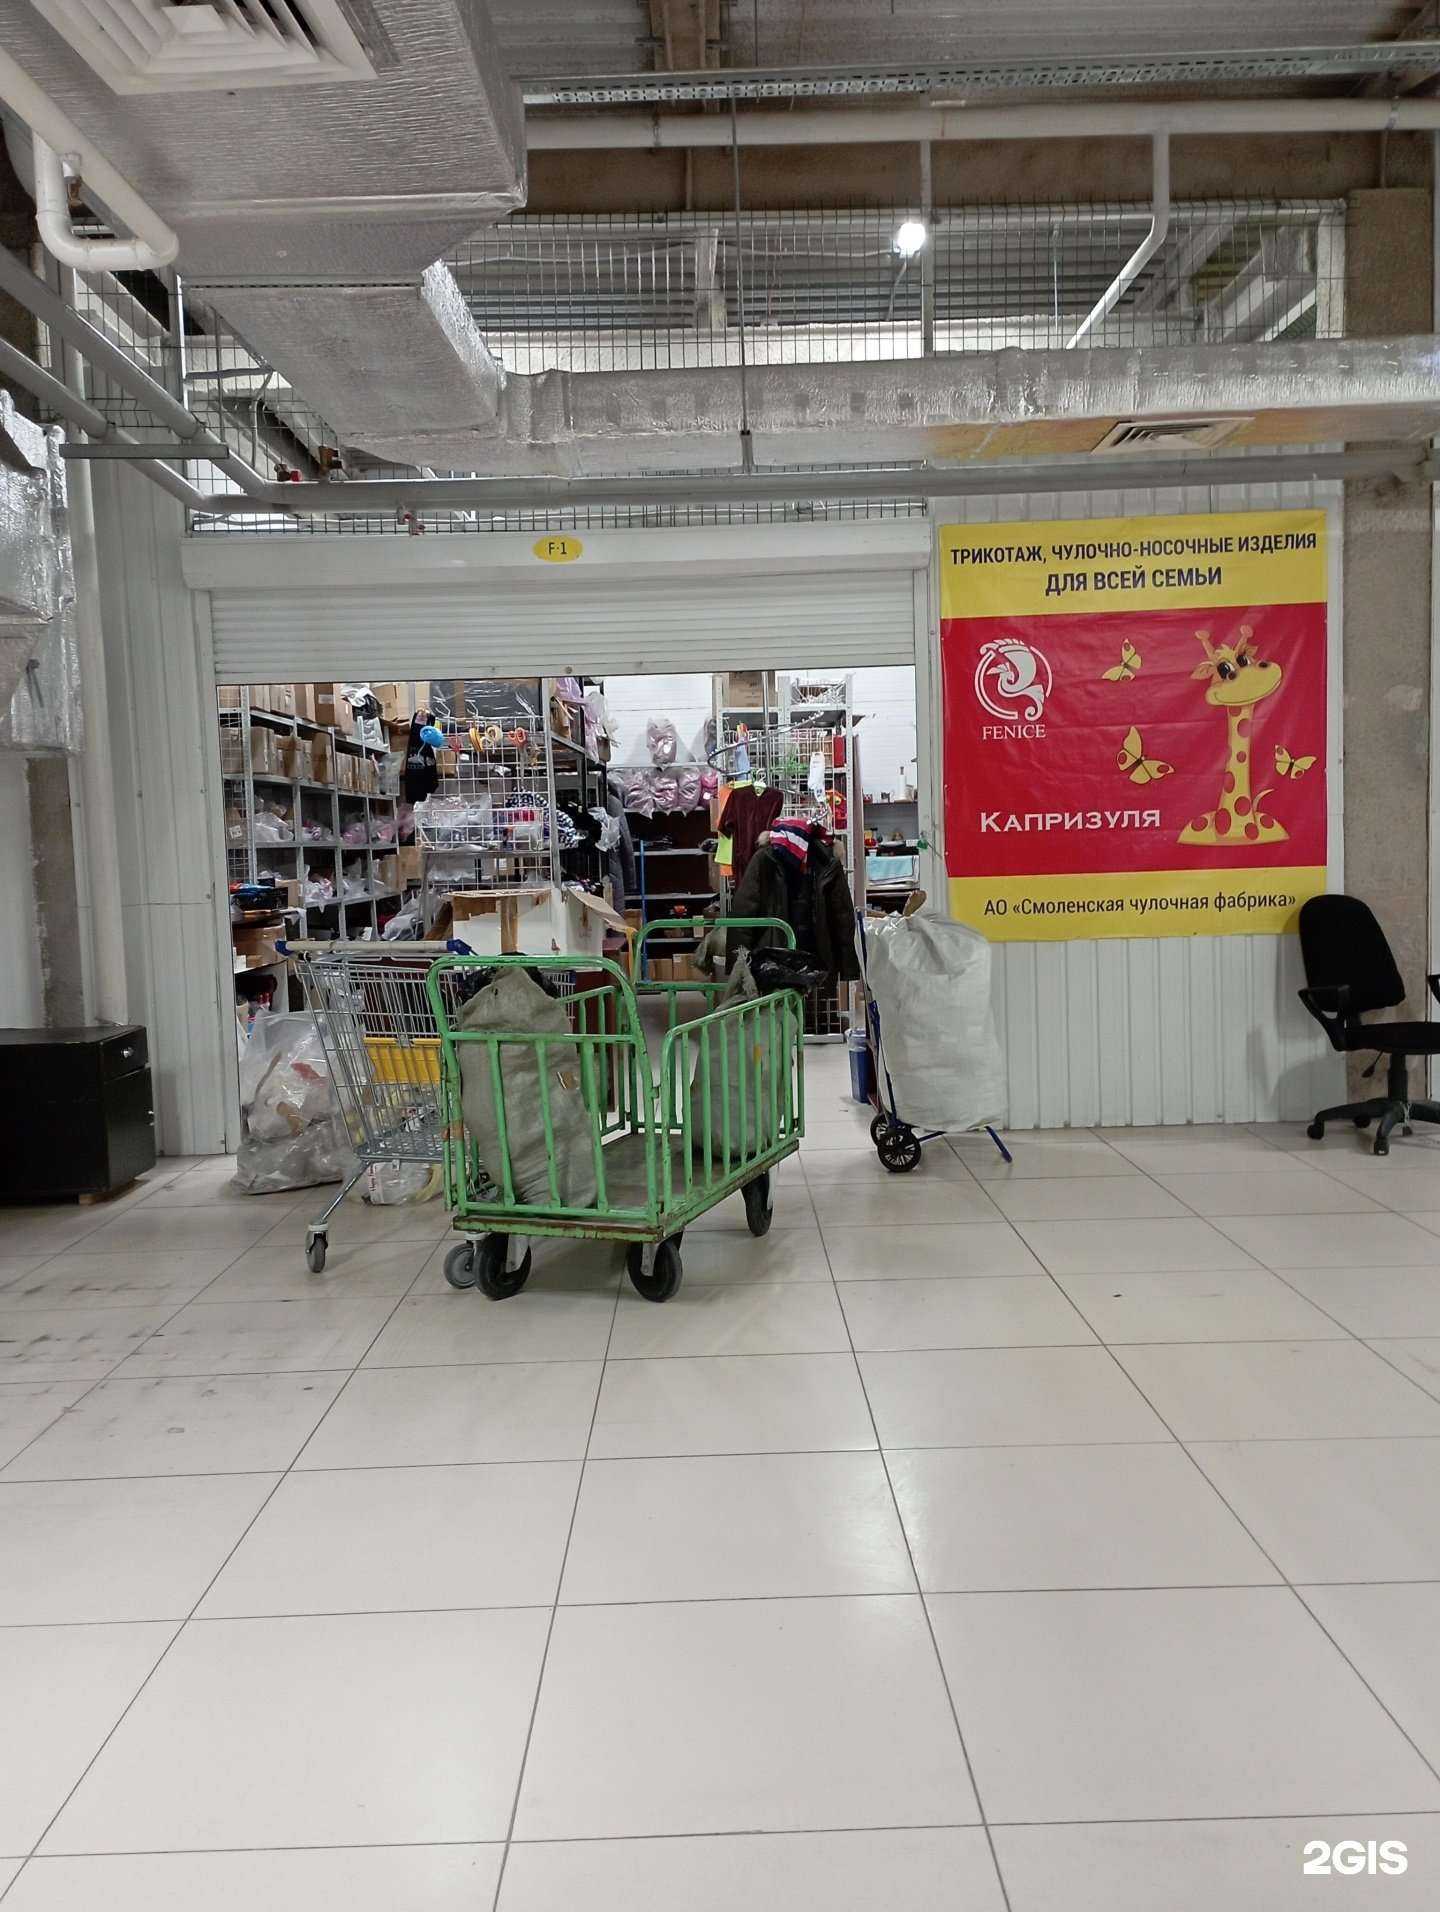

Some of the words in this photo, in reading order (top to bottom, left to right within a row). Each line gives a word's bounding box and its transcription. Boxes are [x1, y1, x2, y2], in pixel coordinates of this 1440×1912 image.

[950, 545, 1048, 565] ТРИКОТАЖ,
[1051, 536, 1234, 562] ЧУЛОЧНО-НОСОЧНЫЕ
[1237, 532, 1318, 555] ИЗДЕЛИЯ
[1045, 572, 1088, 597] ДЛЯ
[1093, 564, 1147, 591] ВСЕЙ
[1151, 566, 1223, 588] СЕМЬИ
[982, 724, 1047, 741] FENICE
[983, 898, 1008, 916] АО
[1012, 896, 1125, 916] «Смоленская
[1128, 895, 1209, 916] чулочная
[1213, 891, 1296, 912] фабрика»
